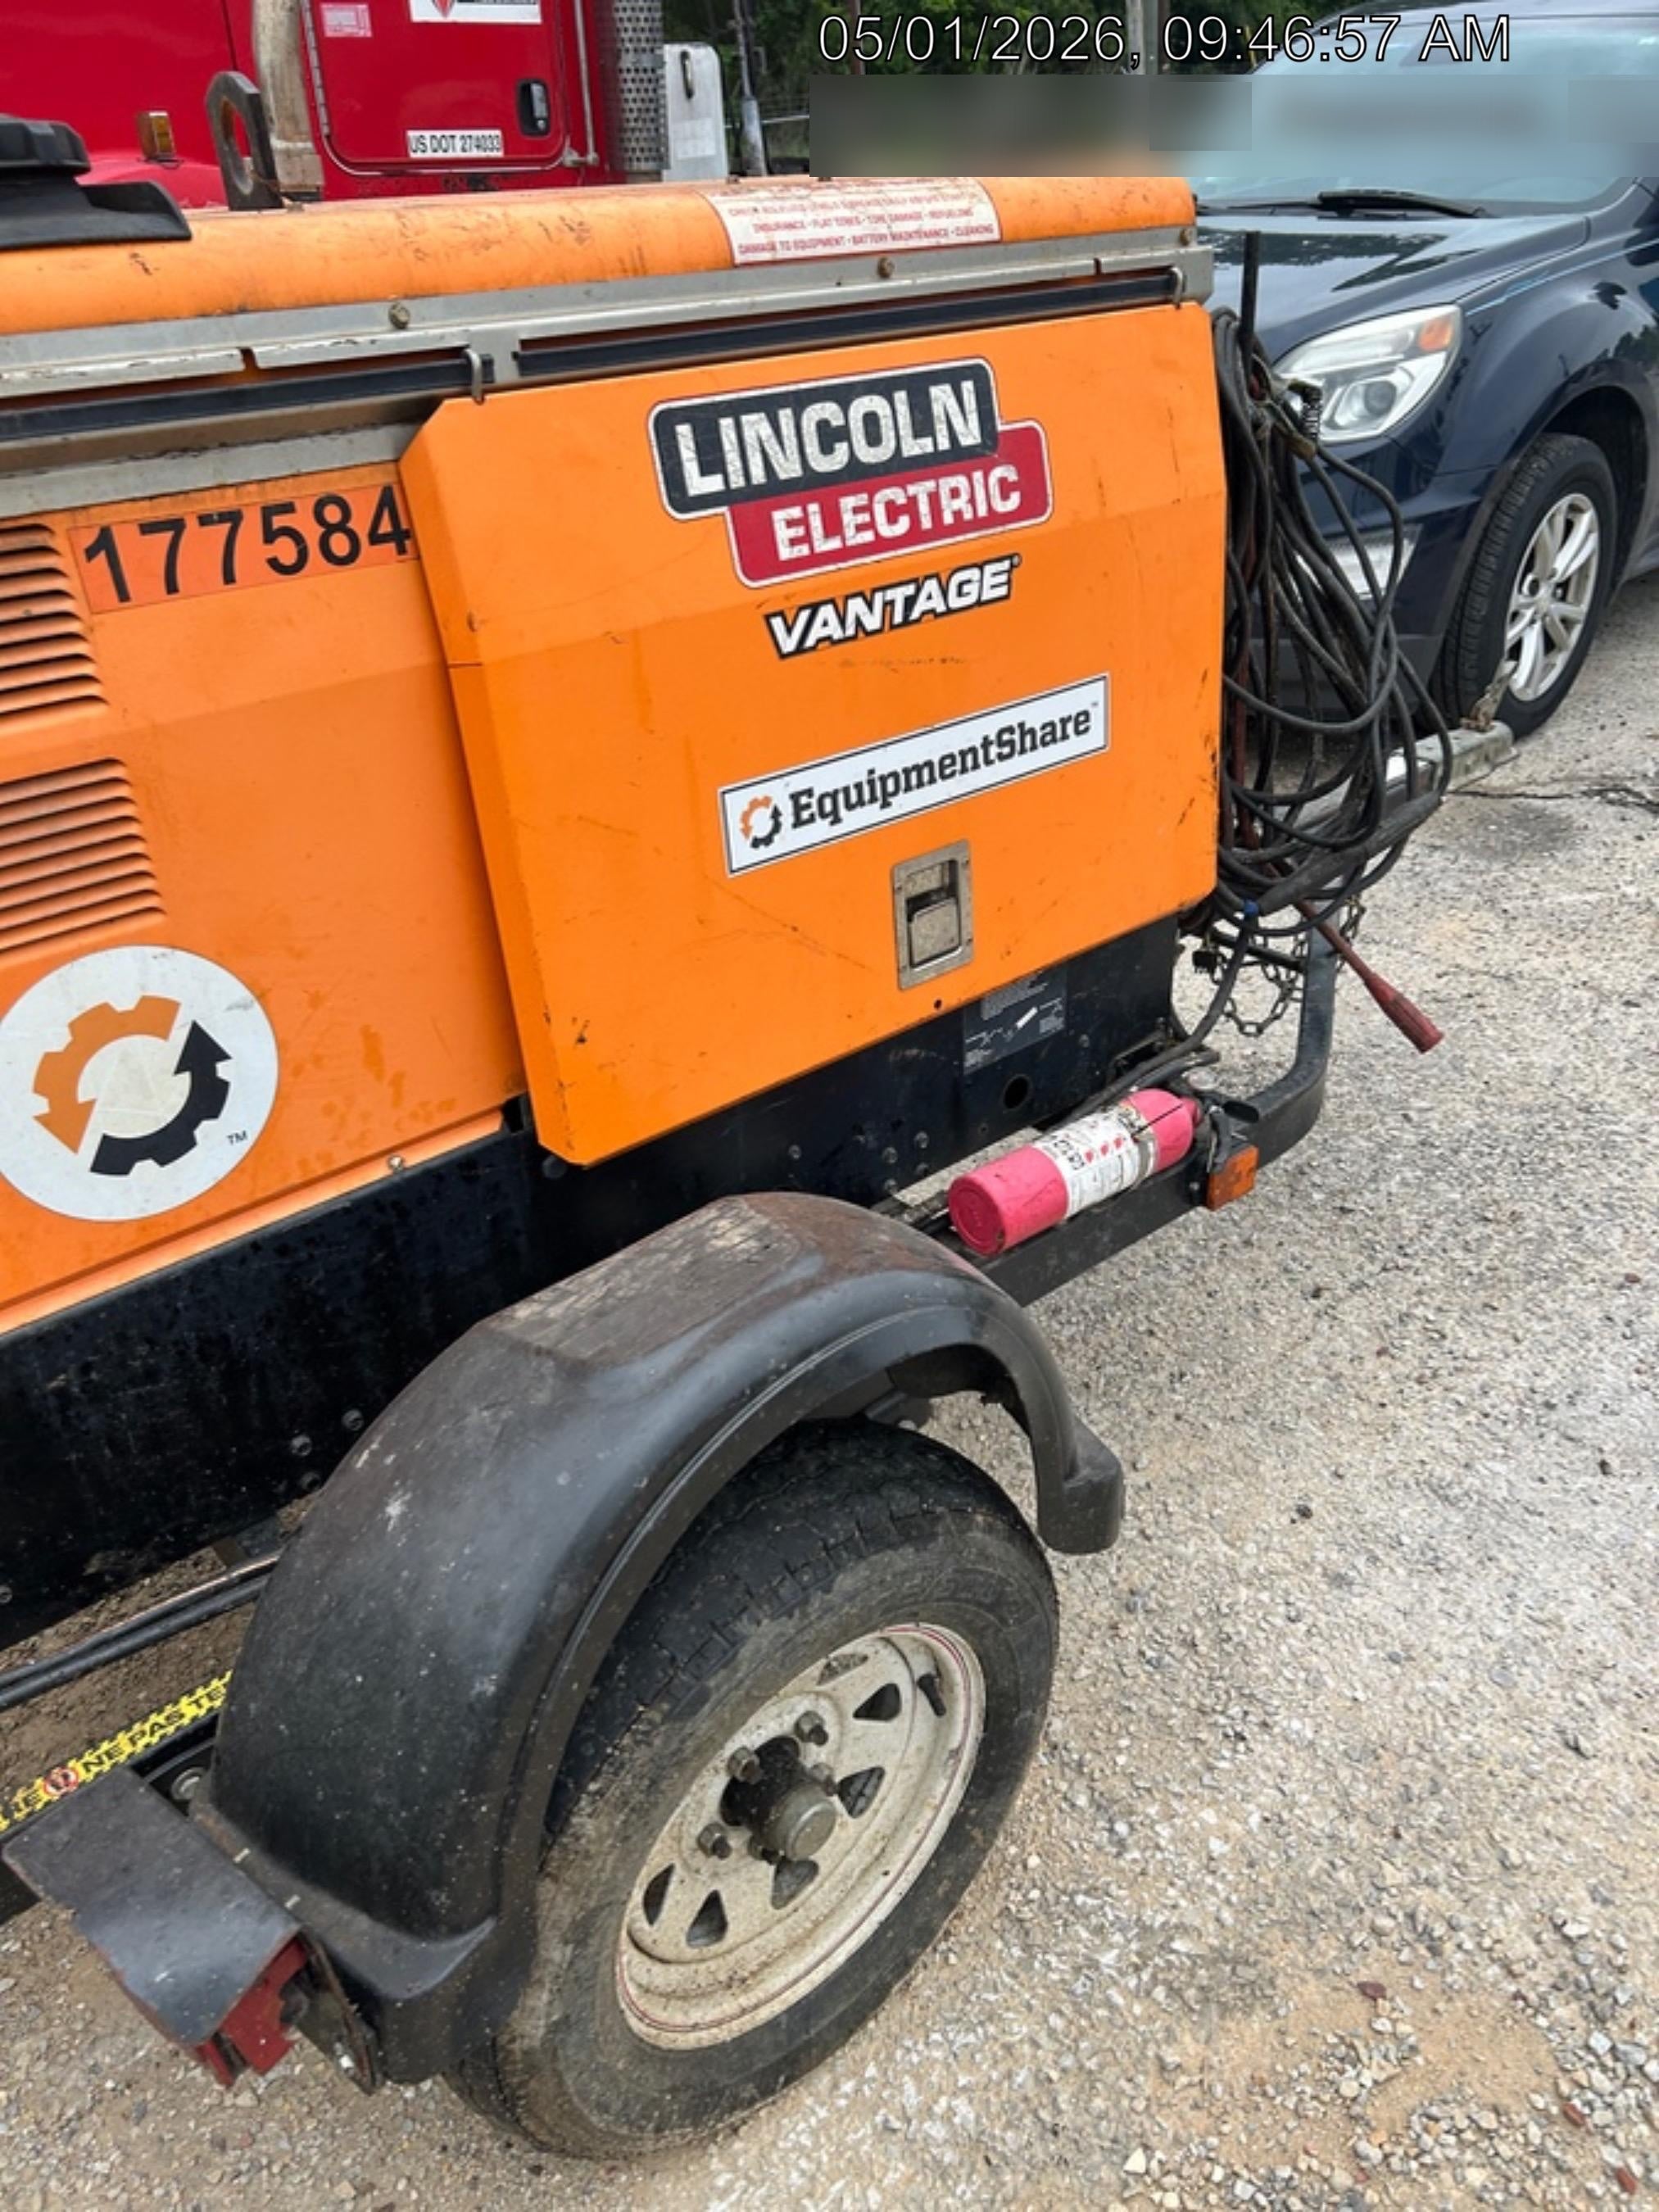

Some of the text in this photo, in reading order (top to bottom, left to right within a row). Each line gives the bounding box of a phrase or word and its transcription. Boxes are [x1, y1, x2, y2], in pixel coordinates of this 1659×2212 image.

[411, 134, 427, 154] US
[430, 134, 456, 154] DOT
[675, 379, 982, 498] LINCOLN
[84, 484, 411, 603] 177584
[771, 464, 1022, 562] ELECTRIC
[766, 556, 1014, 655] VANTAGE
[790, 708, 1091, 829] EquipmentShare
